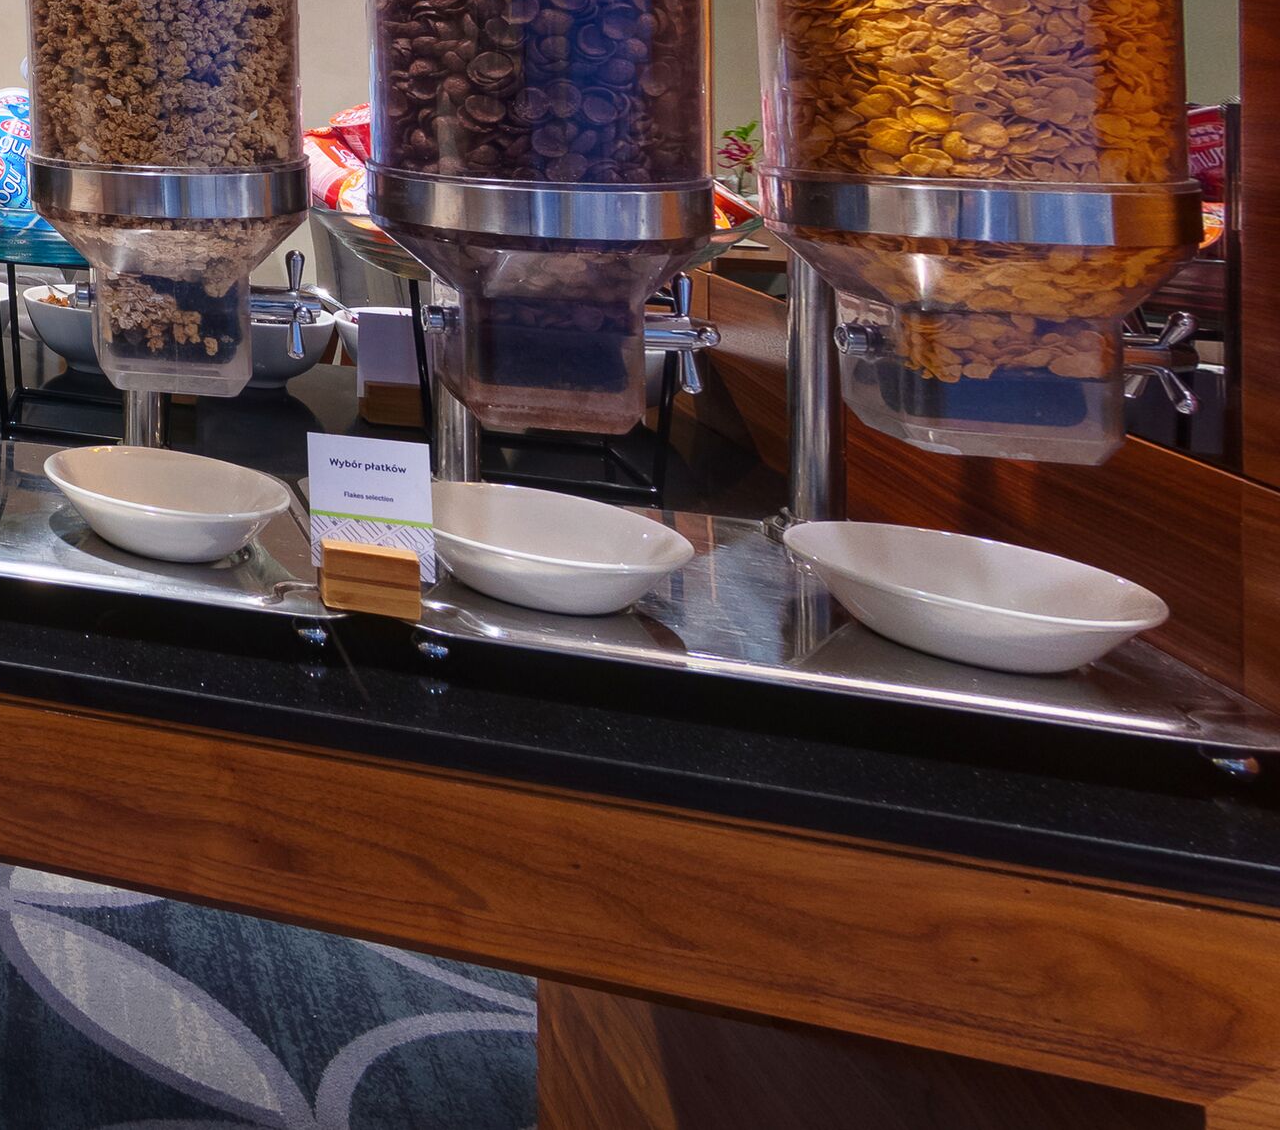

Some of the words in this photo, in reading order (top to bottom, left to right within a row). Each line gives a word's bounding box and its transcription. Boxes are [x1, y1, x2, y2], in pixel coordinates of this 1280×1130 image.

[329, 457, 362, 469] Wybór
[364, 462, 407, 474] płatków
[343, 490, 364, 500] Flakes
[365, 494, 394, 503] selection
